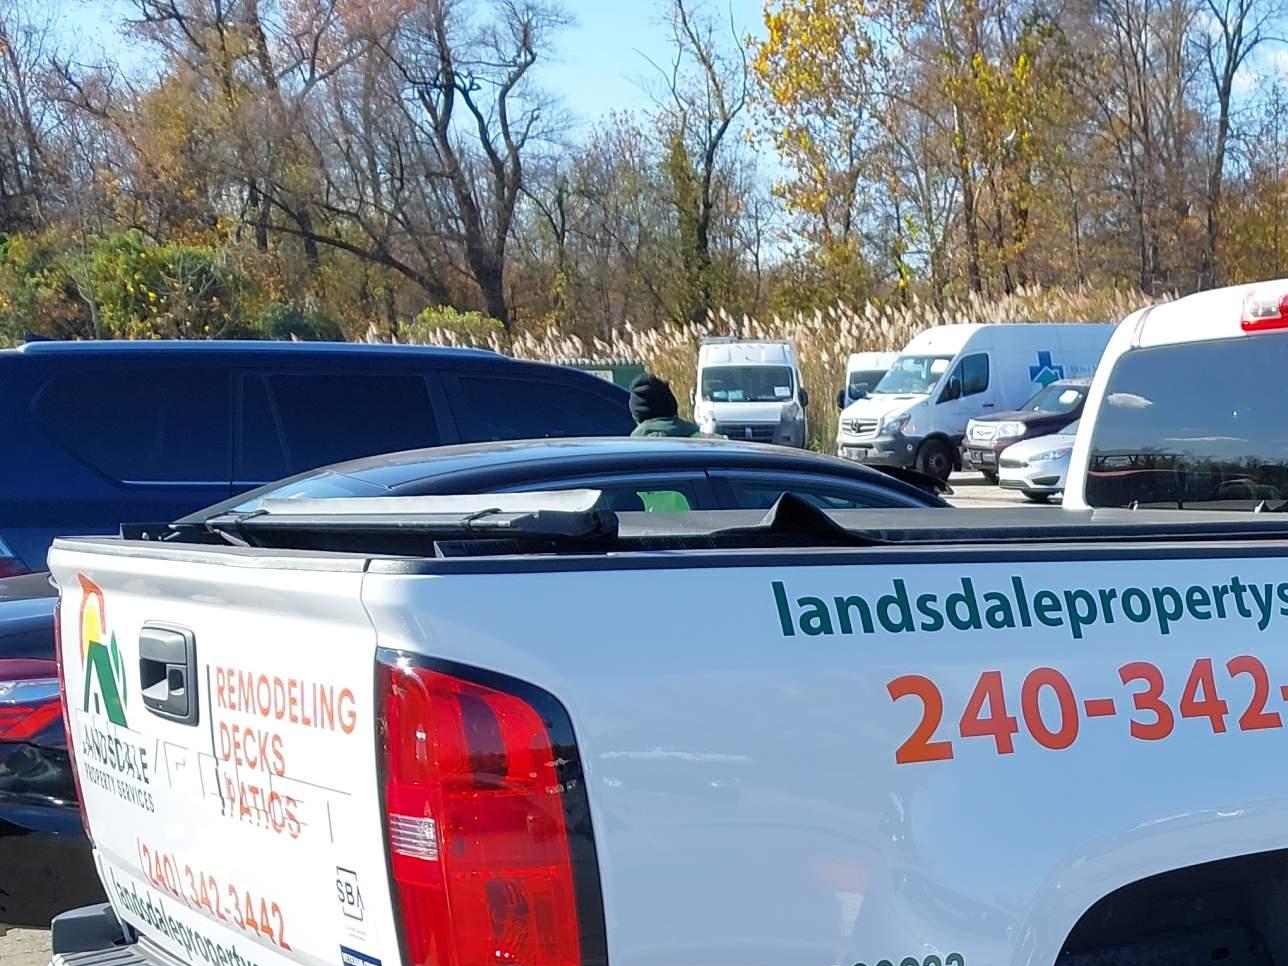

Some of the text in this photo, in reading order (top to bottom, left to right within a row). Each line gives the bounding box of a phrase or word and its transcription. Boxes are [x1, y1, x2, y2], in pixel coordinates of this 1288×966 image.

[216, 666, 357, 735] REMODELING
[220, 721, 286, 777] DECKS
[117, 778, 155, 813] SERVICES
[226, 776, 302, 839] PATIOS
[137, 836, 293, 952] (240) 342-3442
